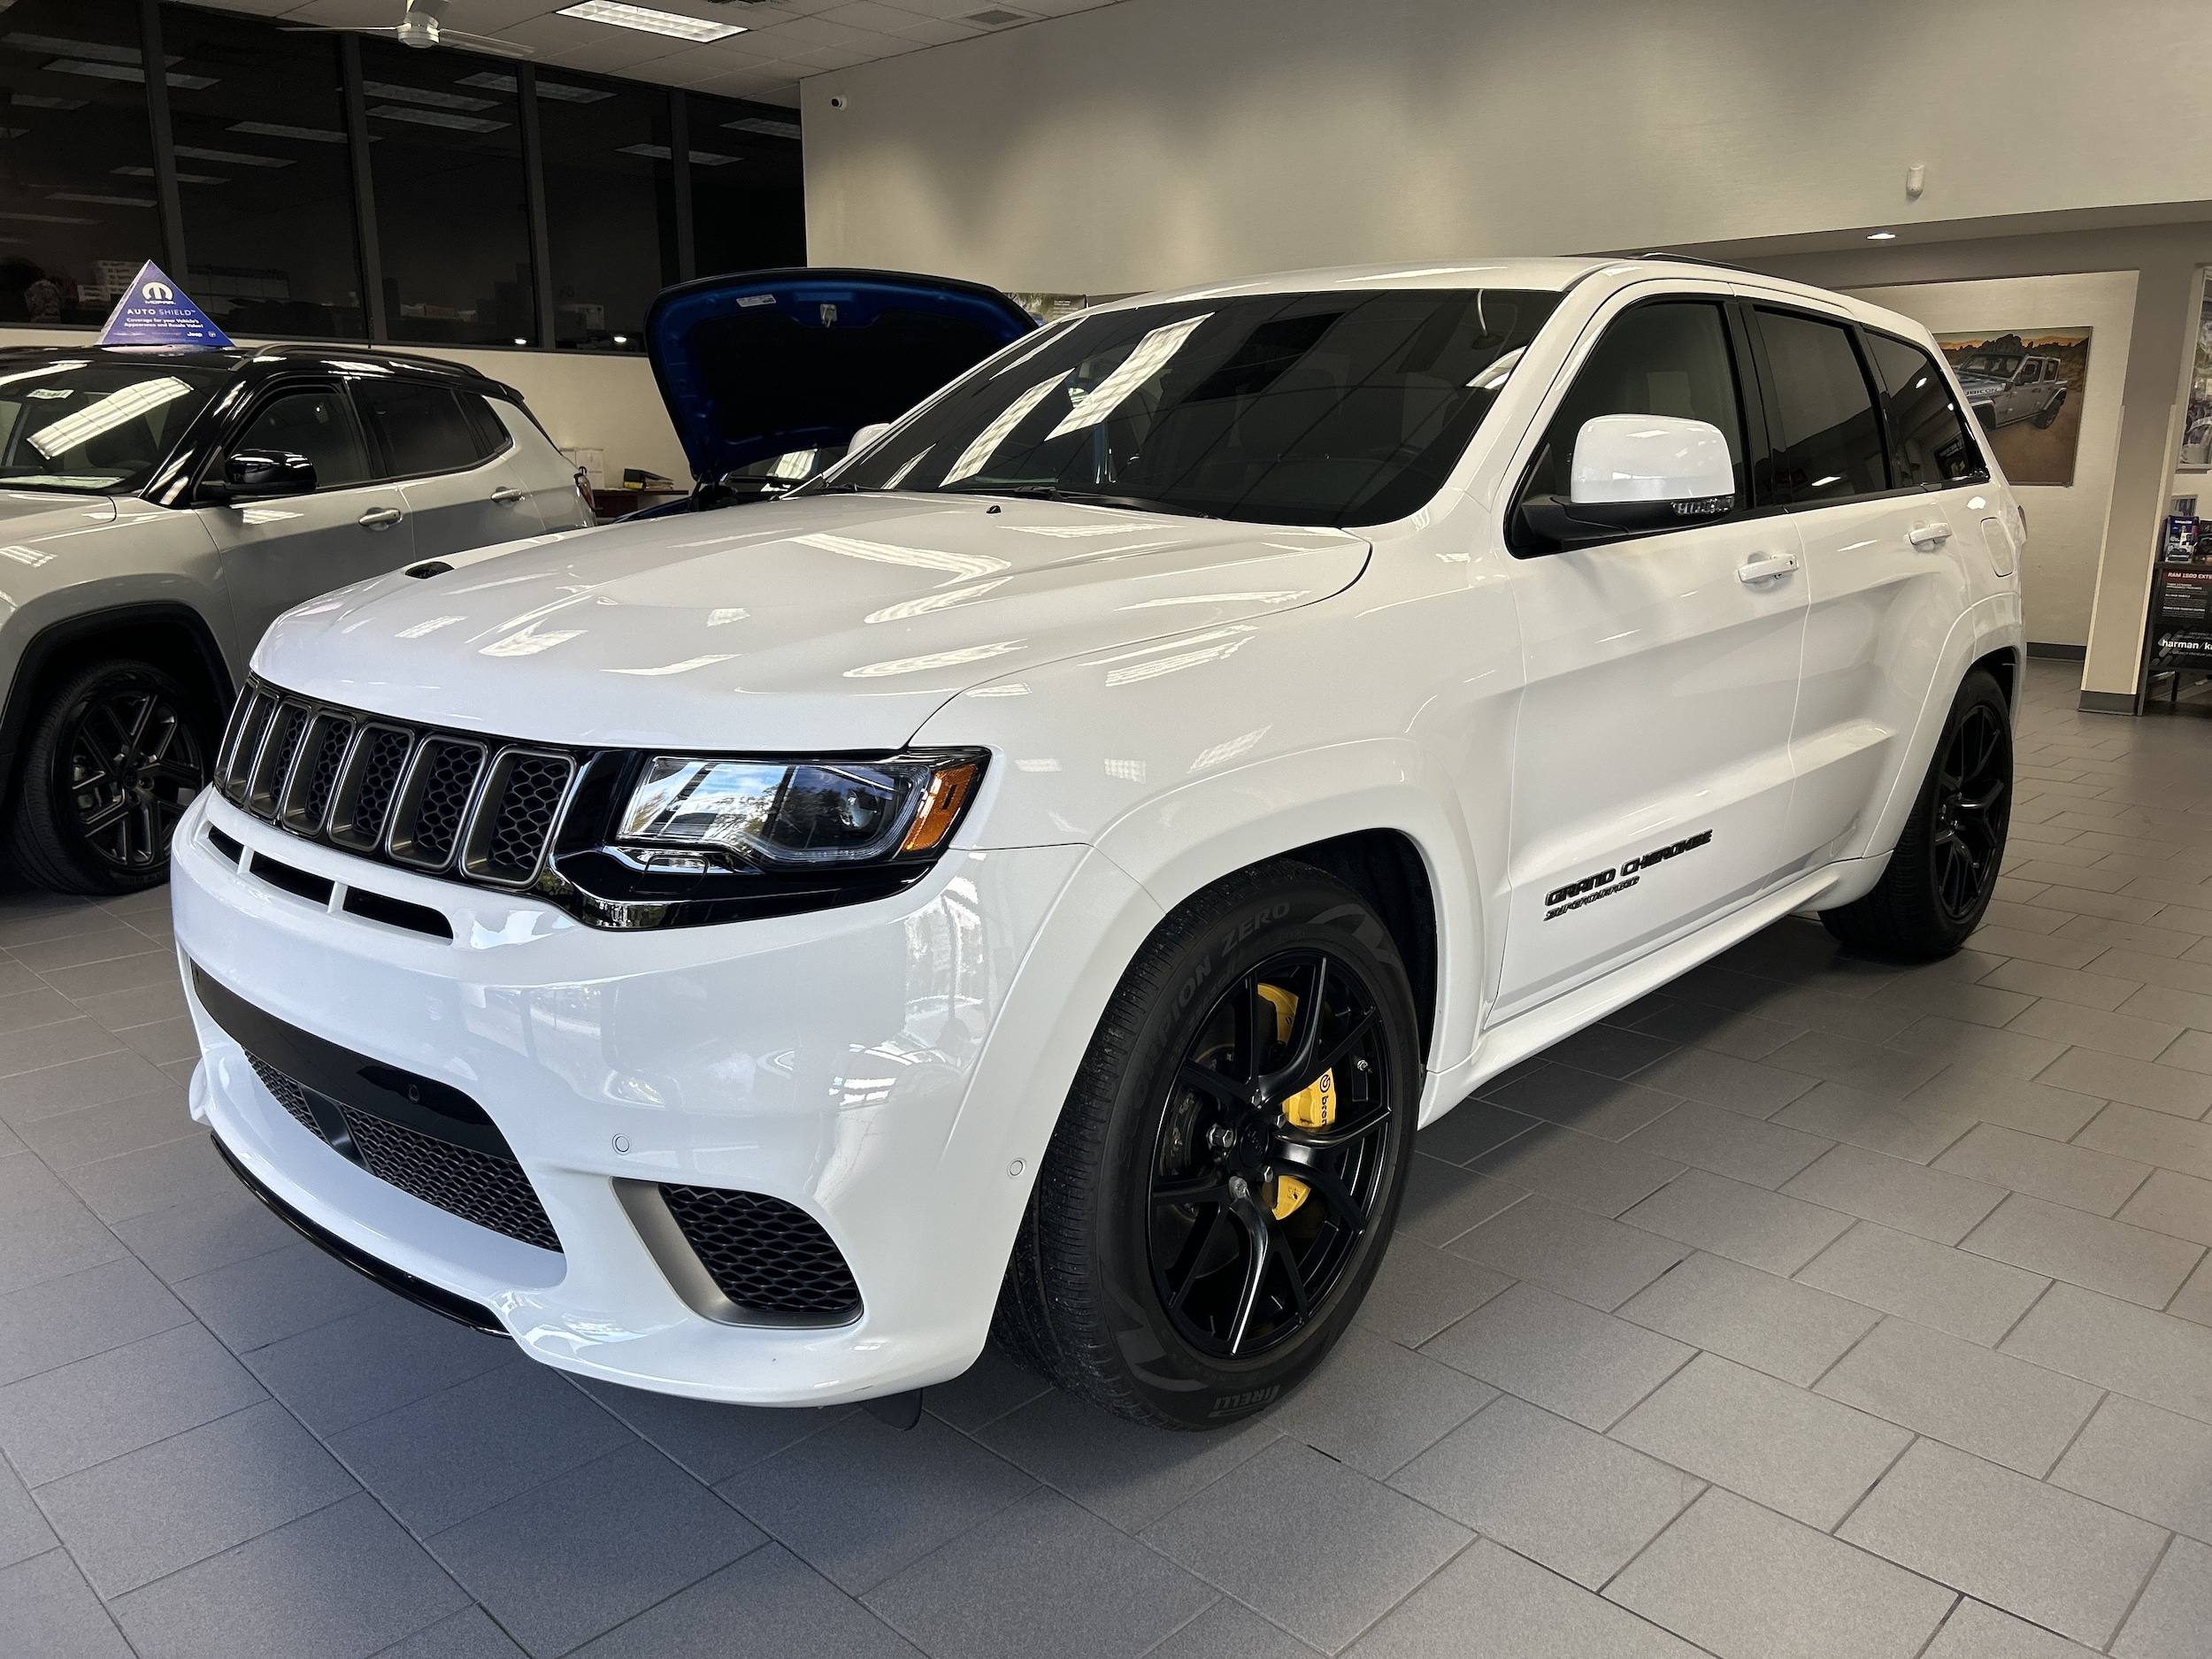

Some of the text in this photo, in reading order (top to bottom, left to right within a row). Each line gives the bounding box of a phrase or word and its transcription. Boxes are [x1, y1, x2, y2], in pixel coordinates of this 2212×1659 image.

[1544, 829, 1713, 906] GRAND CHEROKEE
[1221, 901, 1290, 958] ZERO
[1207, 1383, 1281, 1418] PIRELLI
